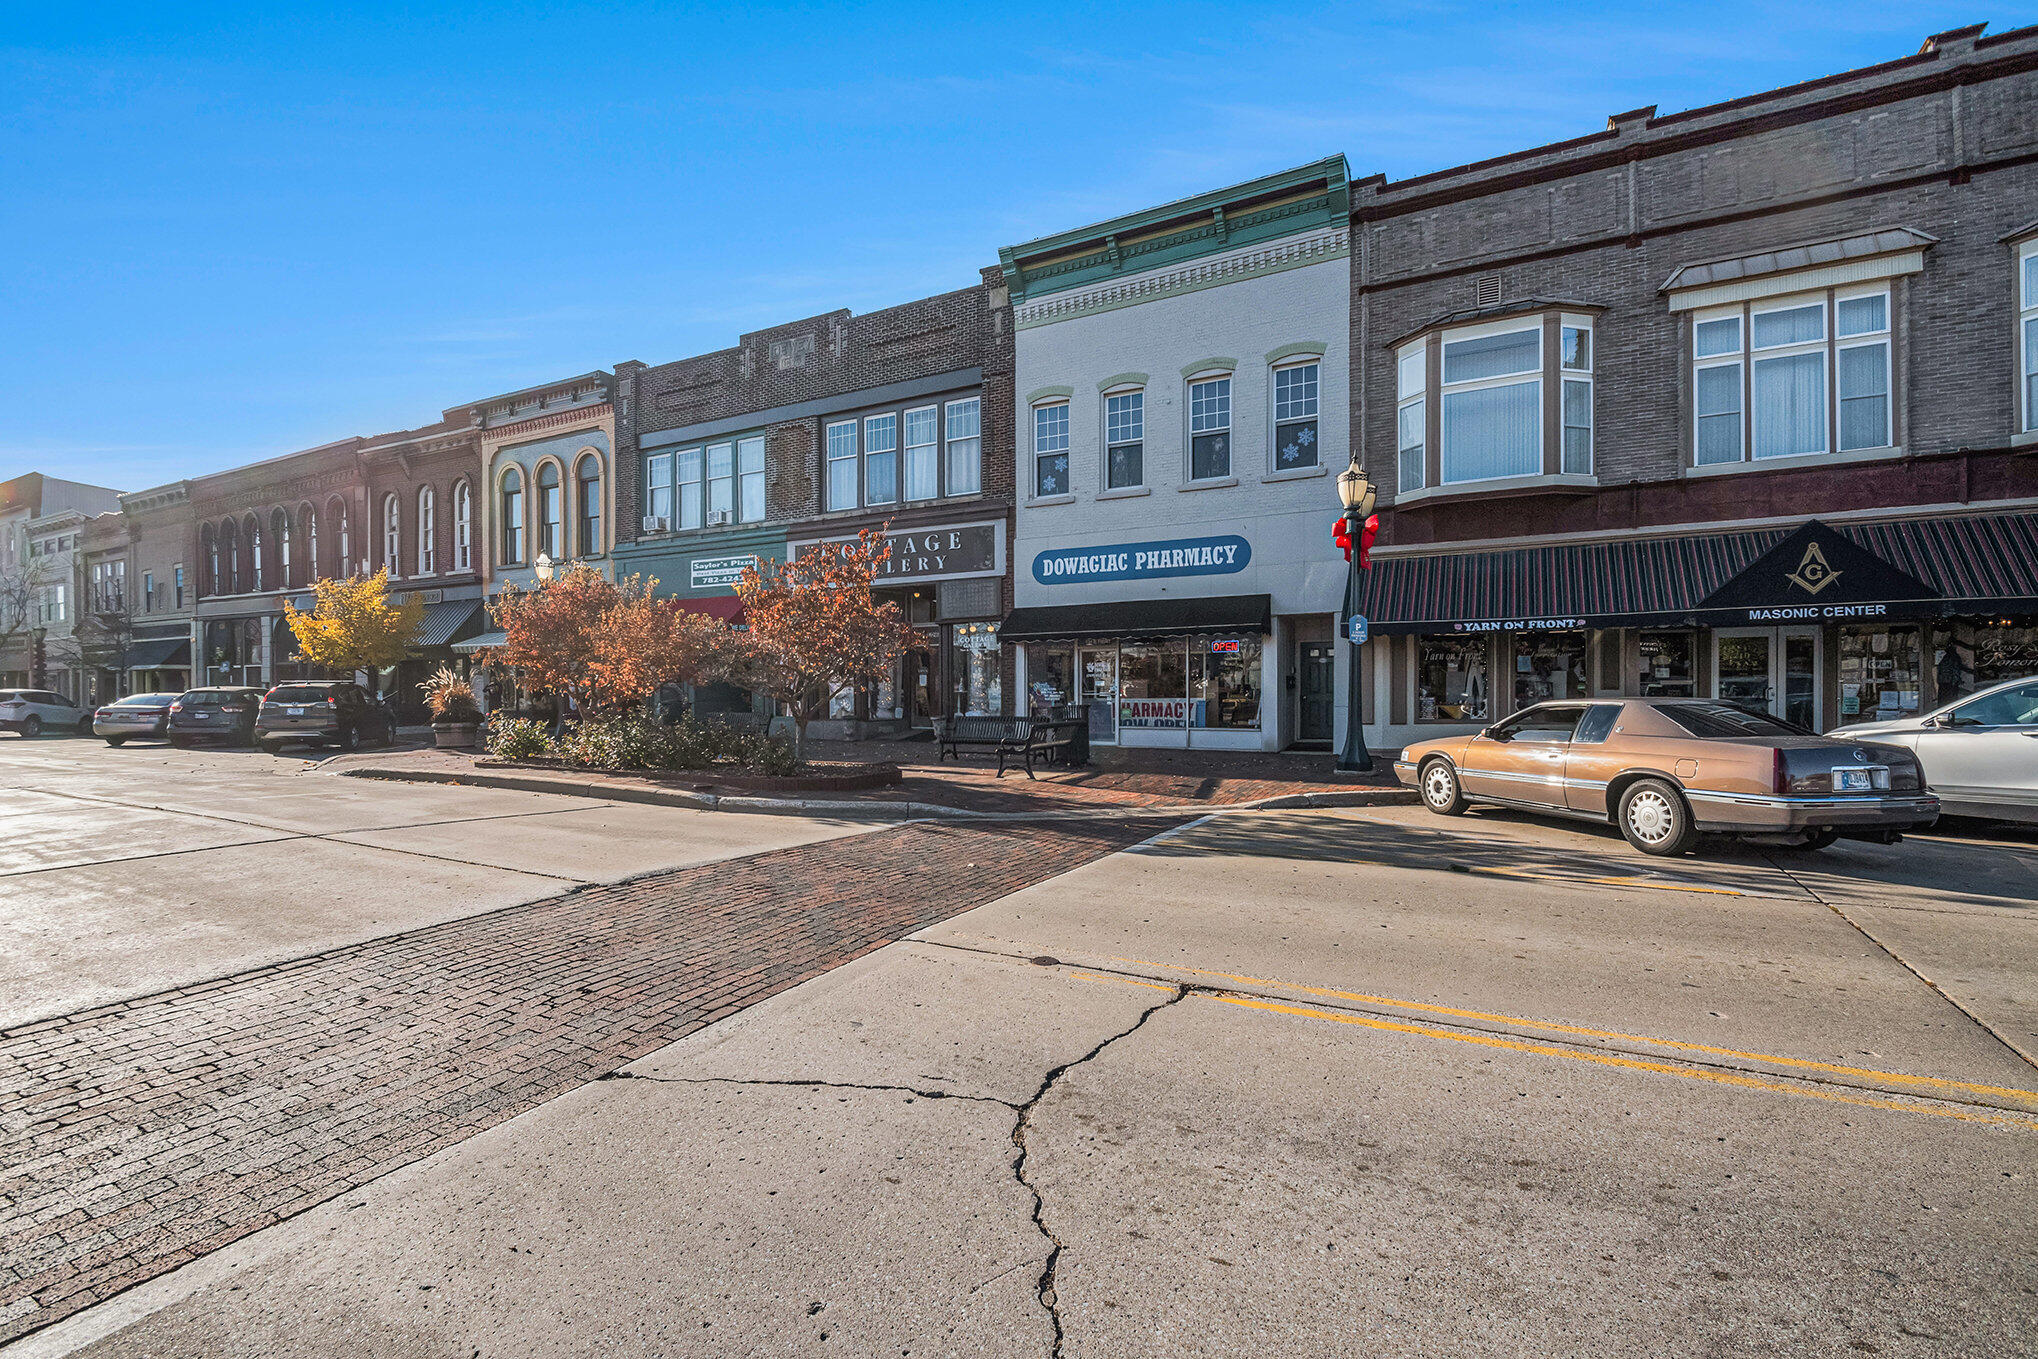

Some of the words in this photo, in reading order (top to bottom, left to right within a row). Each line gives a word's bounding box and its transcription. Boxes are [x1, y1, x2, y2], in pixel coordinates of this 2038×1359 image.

[820, 531, 962, 560] OTTAGE
[694, 562, 728, 570] Saylor's
[1043, 553, 1128, 576] DOWAGIAC
[1135, 545, 1237, 569] PHARMACY
[1749, 607, 1819, 619] MASONIC
[1823, 604, 1887, 617] CENTER
[1464, 622, 1501, 631] YARN
[1503, 621, 1524, 630] ON
[1527, 619, 1576, 629] FRONT
[1213, 642, 1238, 651] OPEN
[1425, 648, 1444, 660] Yarn
[1981, 639, 2025, 657] Rosy
[1112, 702, 1195, 718] ARMACY
